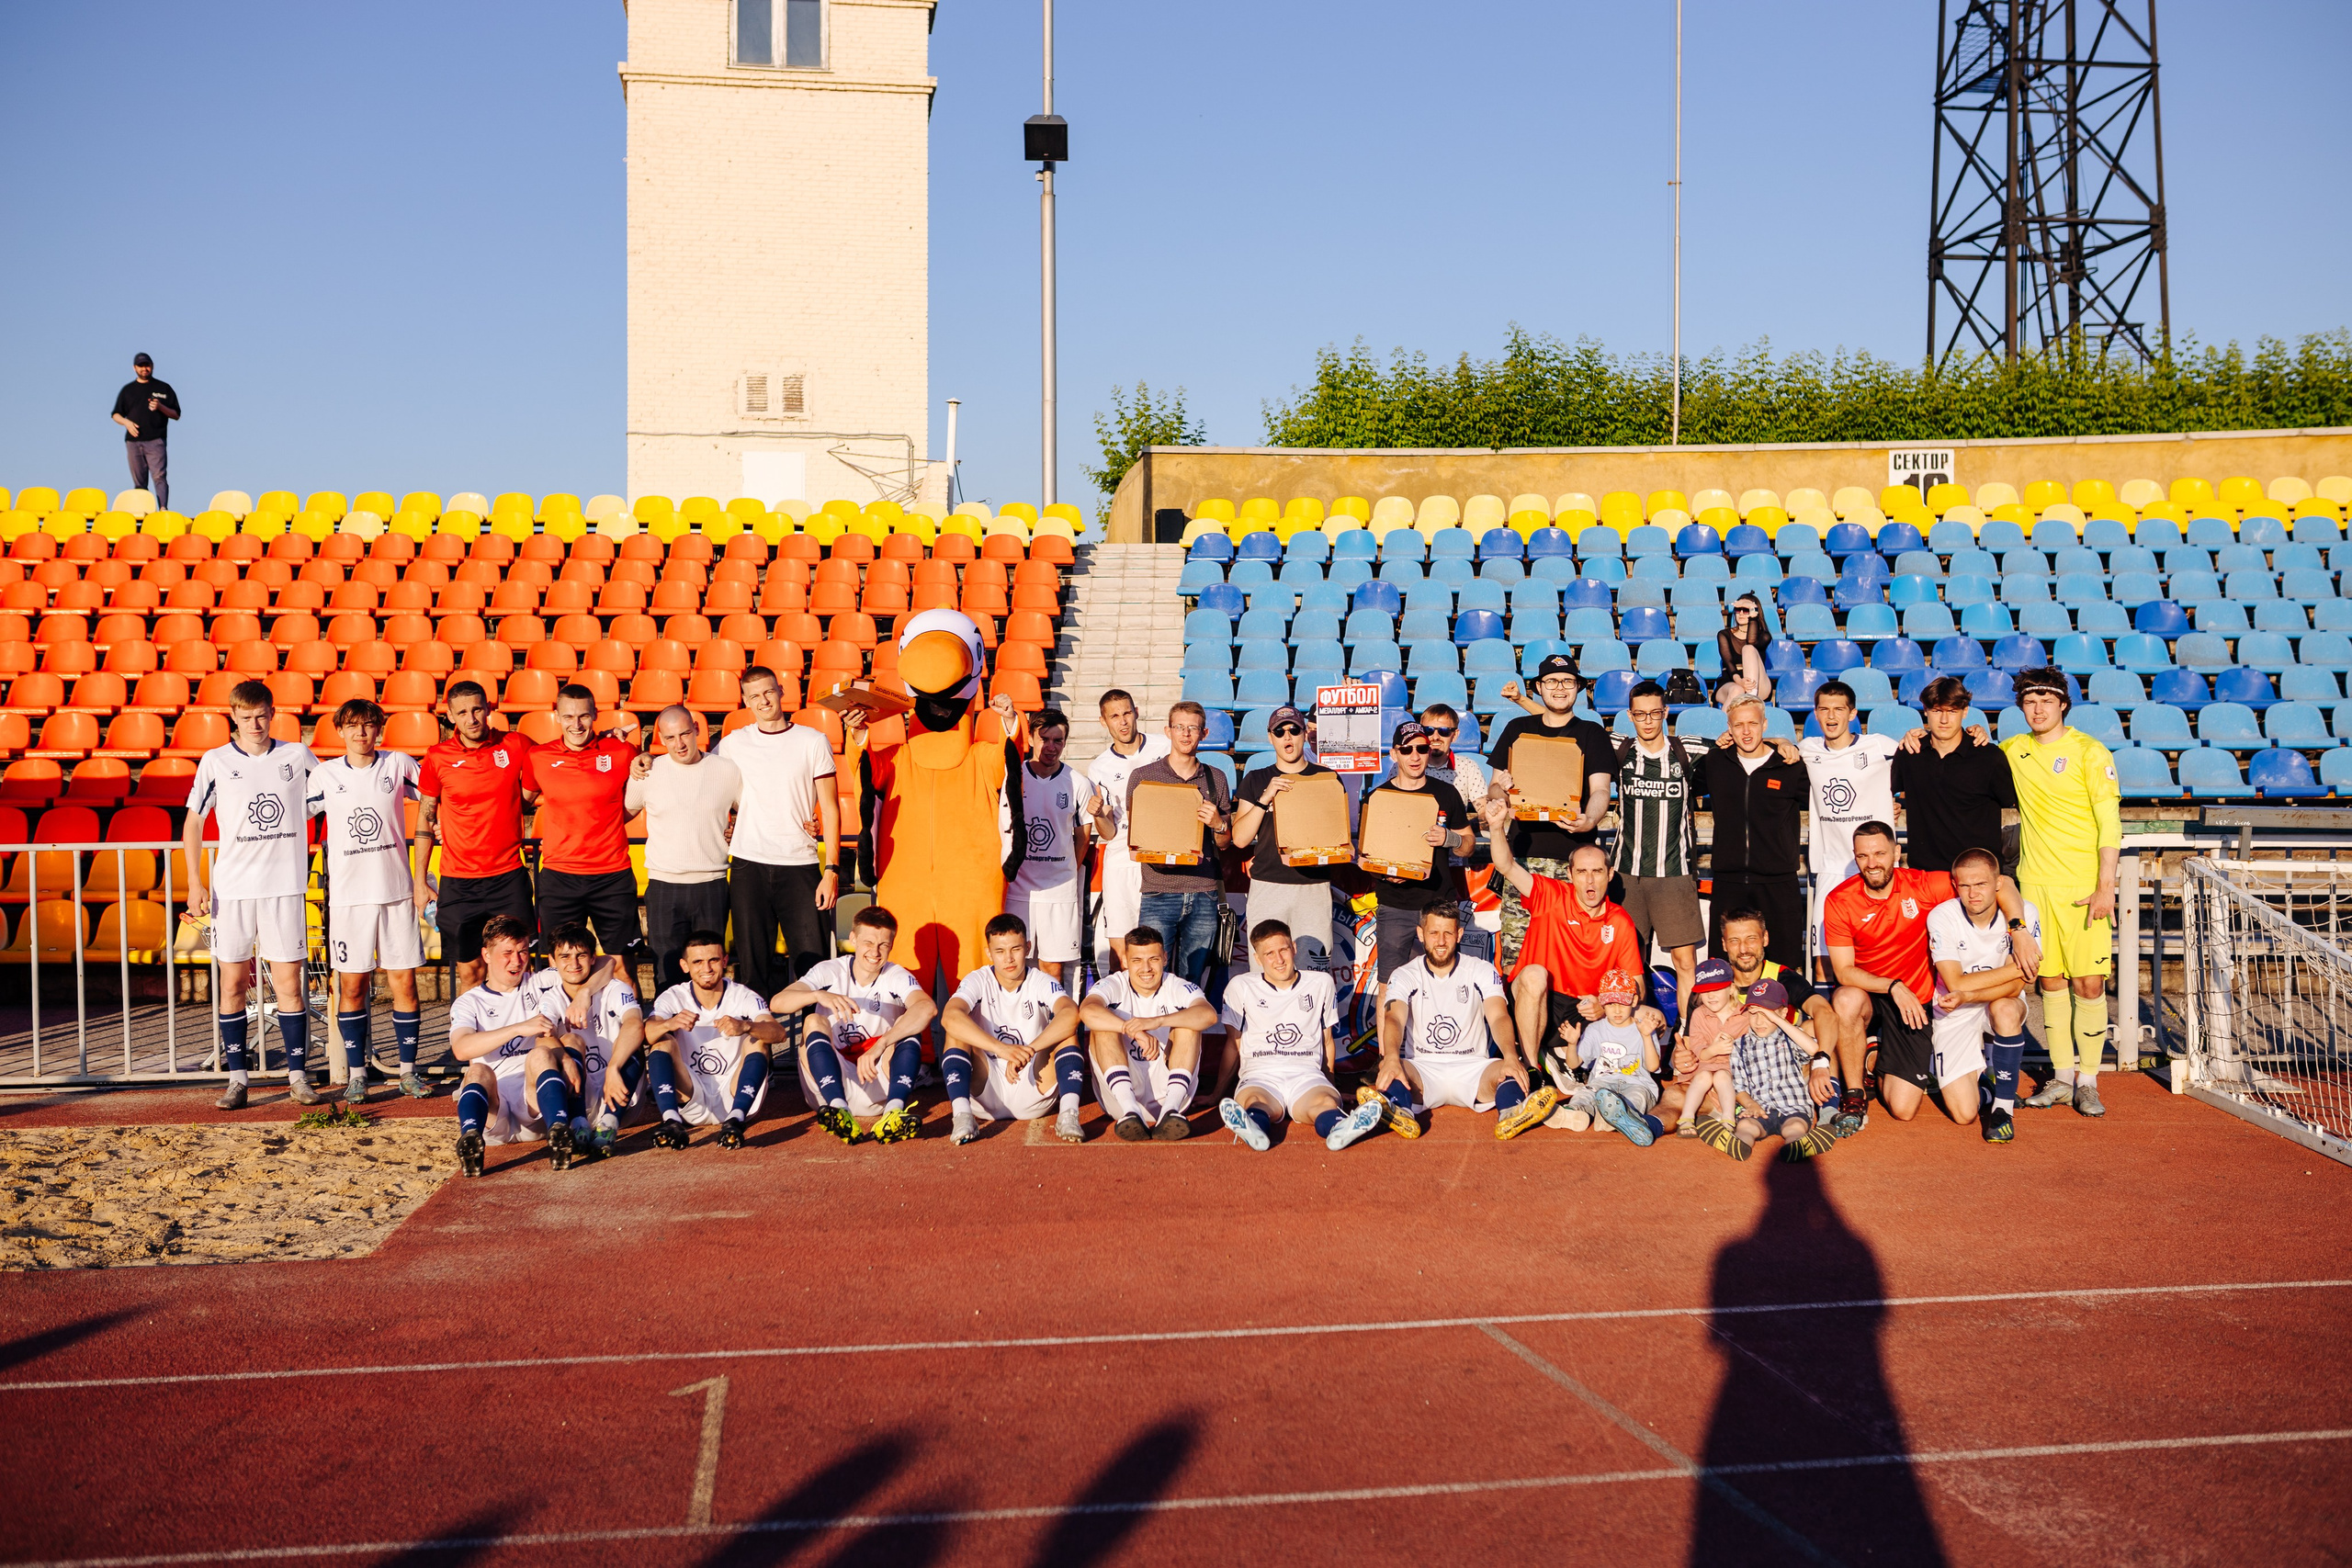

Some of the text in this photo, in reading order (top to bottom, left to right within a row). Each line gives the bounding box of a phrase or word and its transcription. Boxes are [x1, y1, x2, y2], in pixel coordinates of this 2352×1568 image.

[1894, 453, 1949, 470] СЕКТОР
[1319, 687, 1377, 705] ФУТБОЛ
[1318, 706, 1348, 715] МЕТАЛЛУРГ
[1631, 777, 1665, 790] Team
[1623, 784, 1665, 797] Viewer
